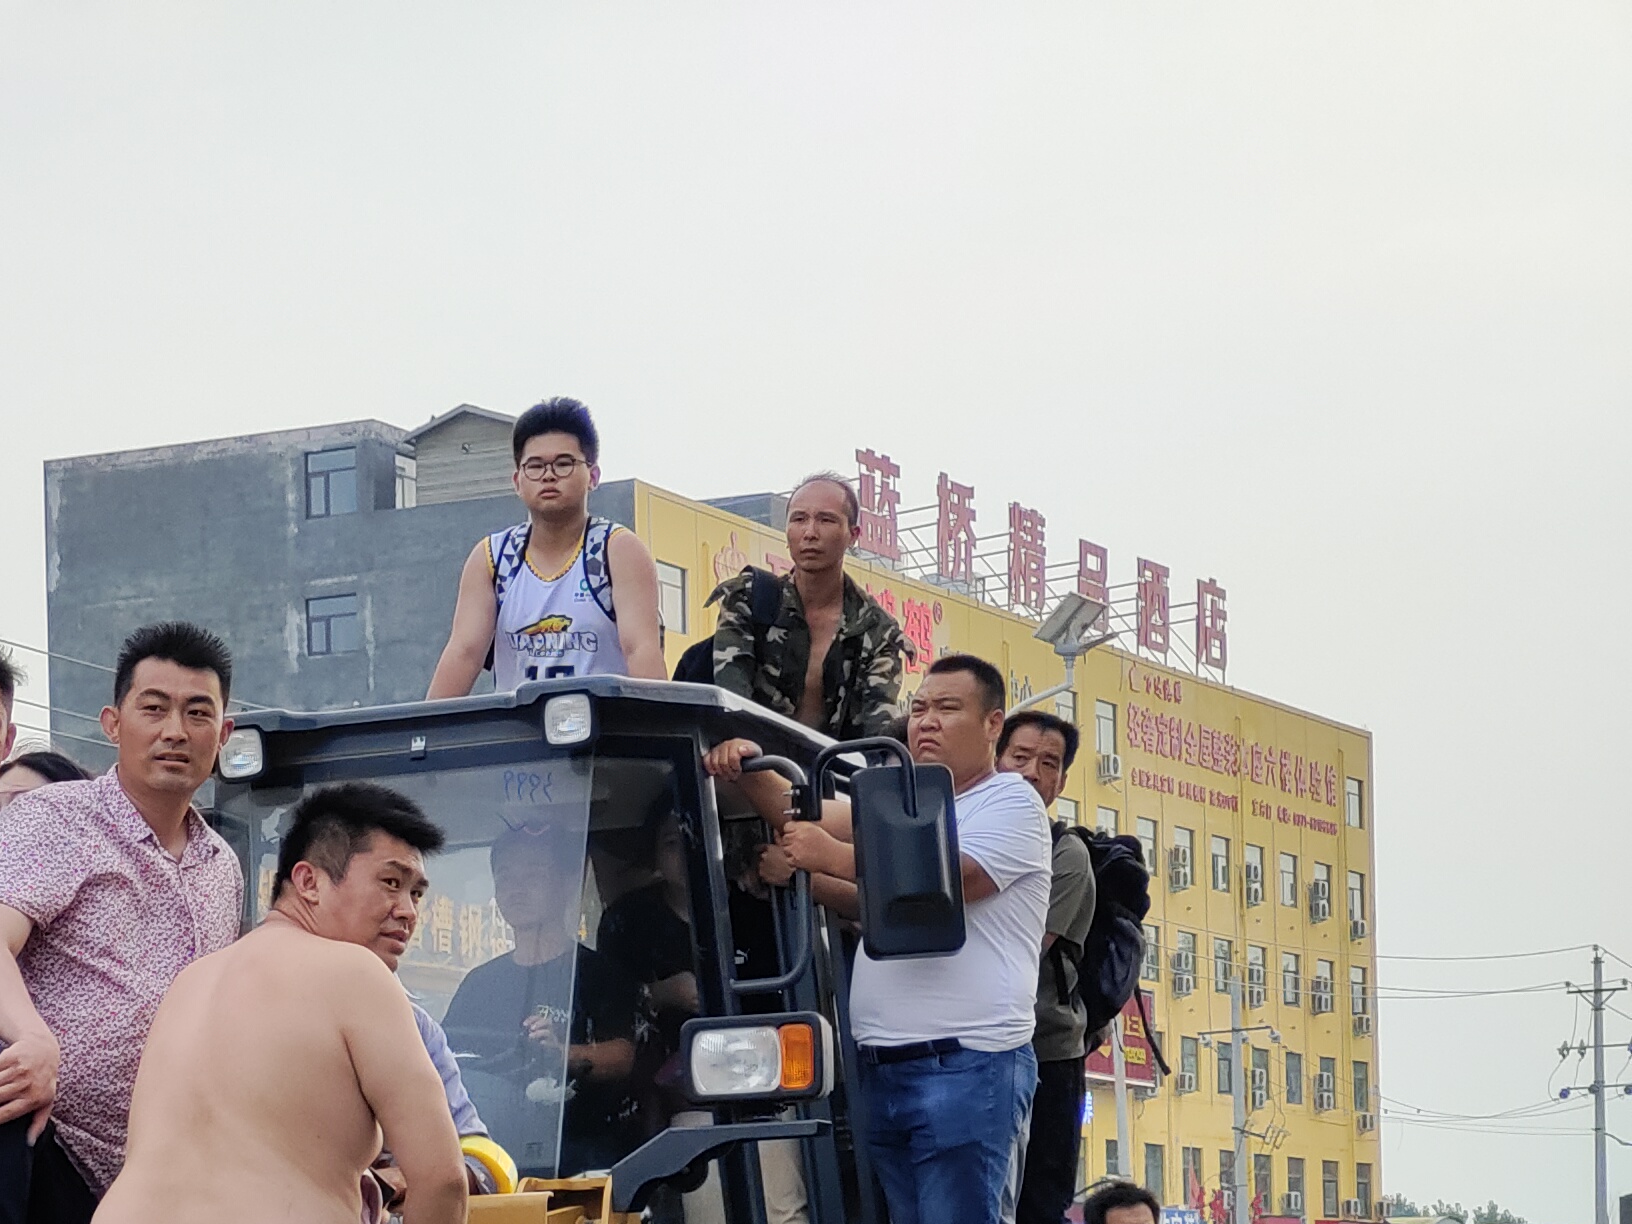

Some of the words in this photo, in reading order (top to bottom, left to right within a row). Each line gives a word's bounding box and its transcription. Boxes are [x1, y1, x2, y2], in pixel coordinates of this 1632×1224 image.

[855, 447, 1228, 670] 蓝桥精品酒店
